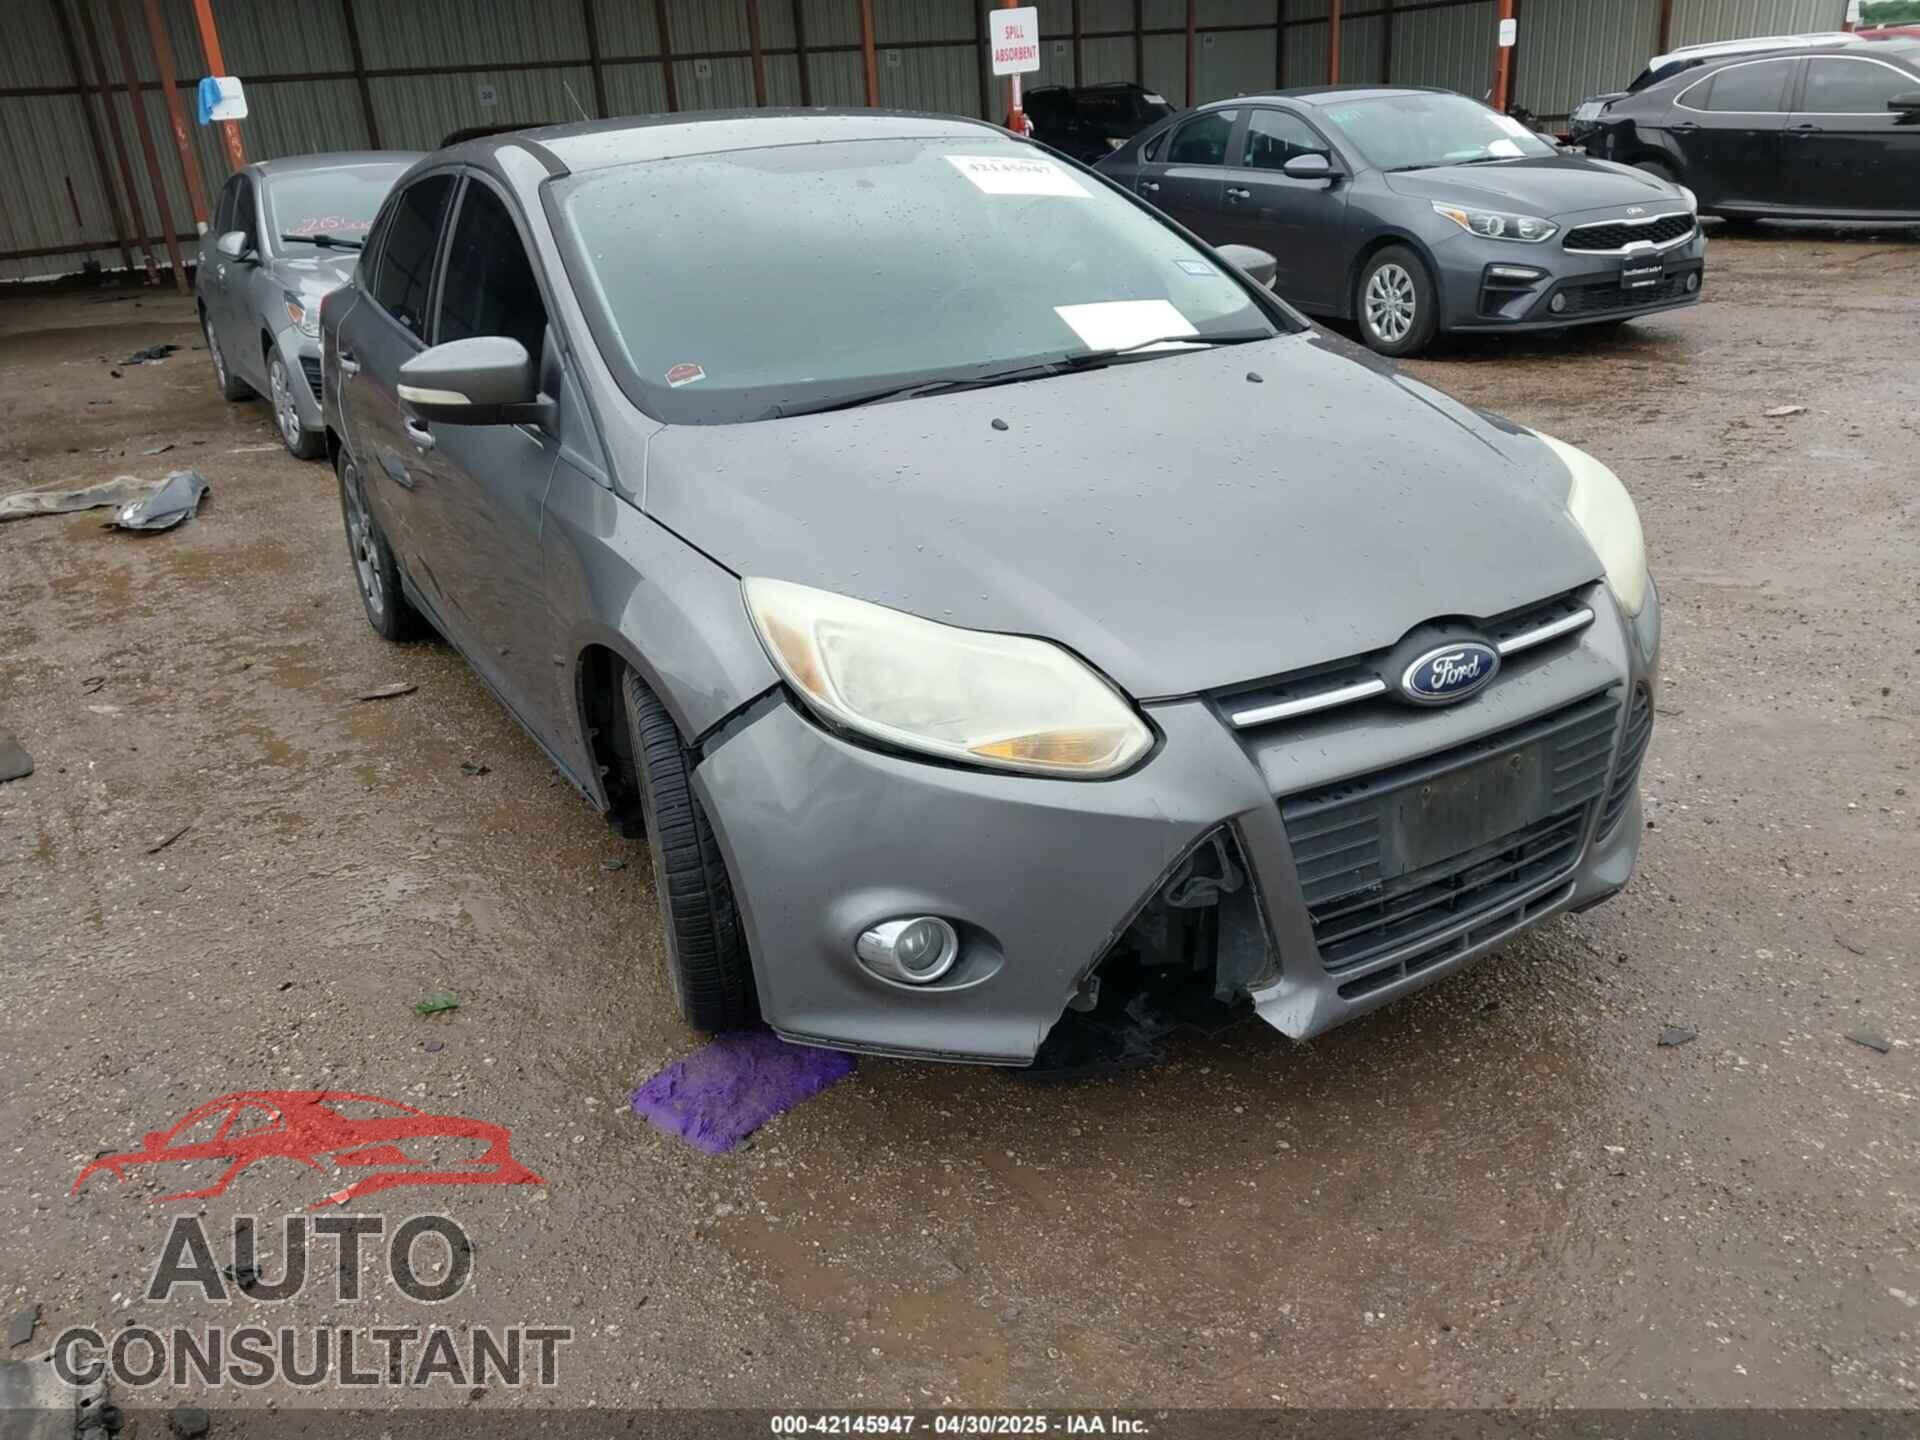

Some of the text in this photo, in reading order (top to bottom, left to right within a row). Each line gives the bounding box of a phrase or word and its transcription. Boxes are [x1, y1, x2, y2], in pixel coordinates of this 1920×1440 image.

[1004, 25, 1024, 40] SPILL
[995, 45, 1037, 62] ABSORBENT
[1431, 652, 1480, 689] Ford
